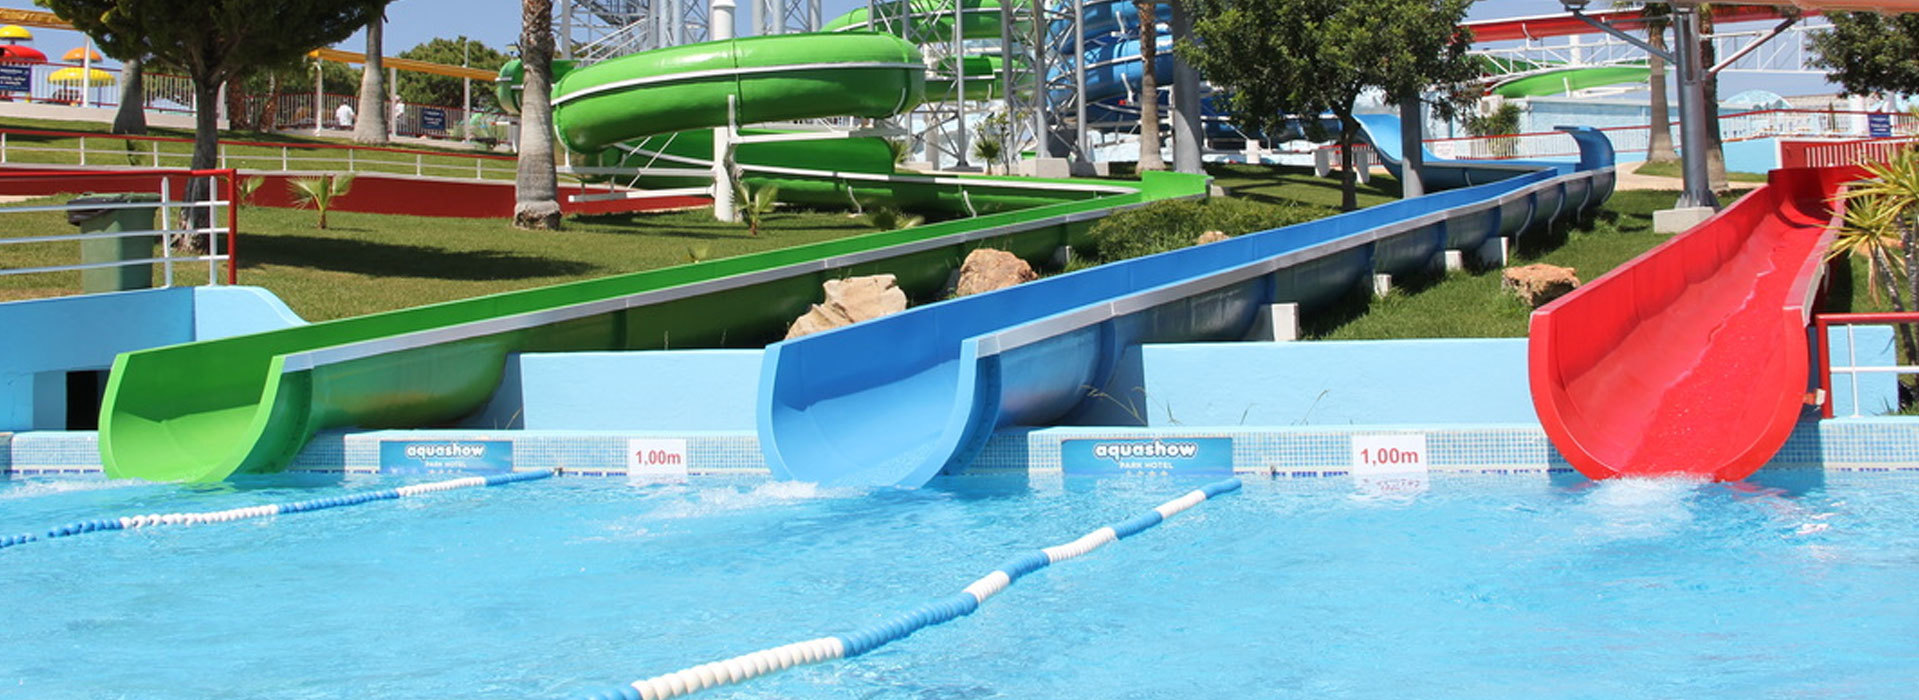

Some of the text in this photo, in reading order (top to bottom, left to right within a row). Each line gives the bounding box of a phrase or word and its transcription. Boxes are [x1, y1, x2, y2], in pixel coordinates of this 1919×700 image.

[406, 442, 486, 460] aquashow
[636, 449, 681, 466] 1,00m
[1094, 440, 1197, 461] aquashow
[1361, 447, 1419, 466] 1,00m
[1119, 461, 1174, 469] PARK HOTEL
